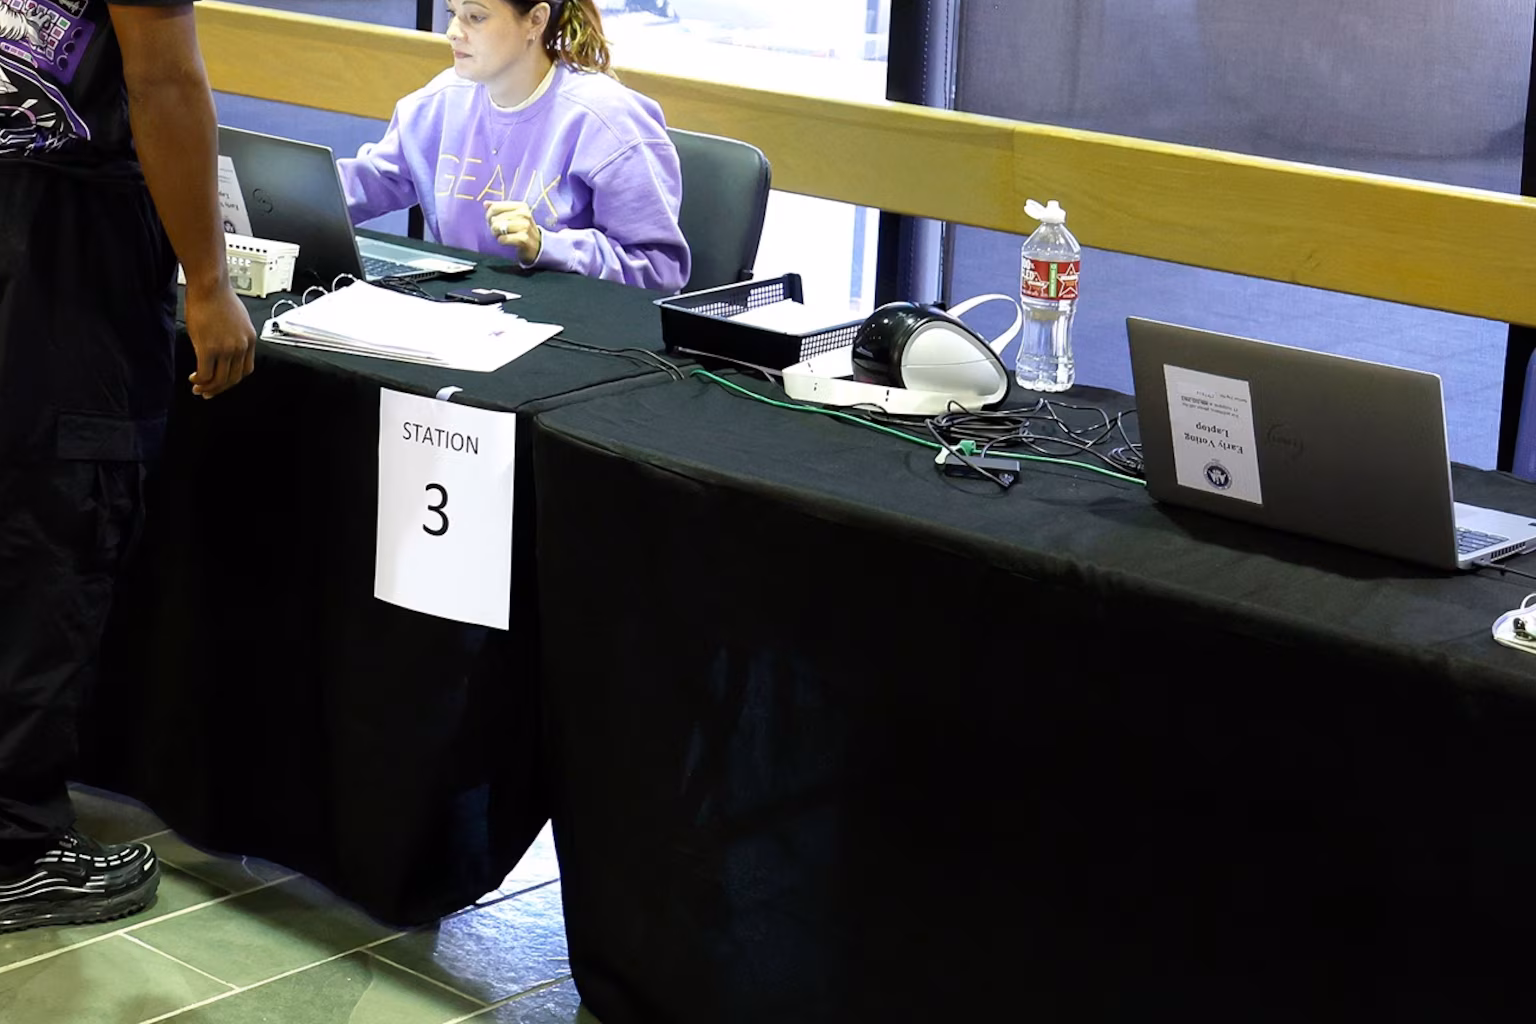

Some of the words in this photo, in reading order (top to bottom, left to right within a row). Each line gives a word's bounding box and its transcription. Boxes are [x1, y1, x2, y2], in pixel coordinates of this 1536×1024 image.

[1196, 422, 1230, 437] Laptop
[402, 421, 479, 455] STATION
[1183, 433, 1216, 448] Voting
[1218, 440, 1244, 454] Early
[422, 482, 450, 537] 3
